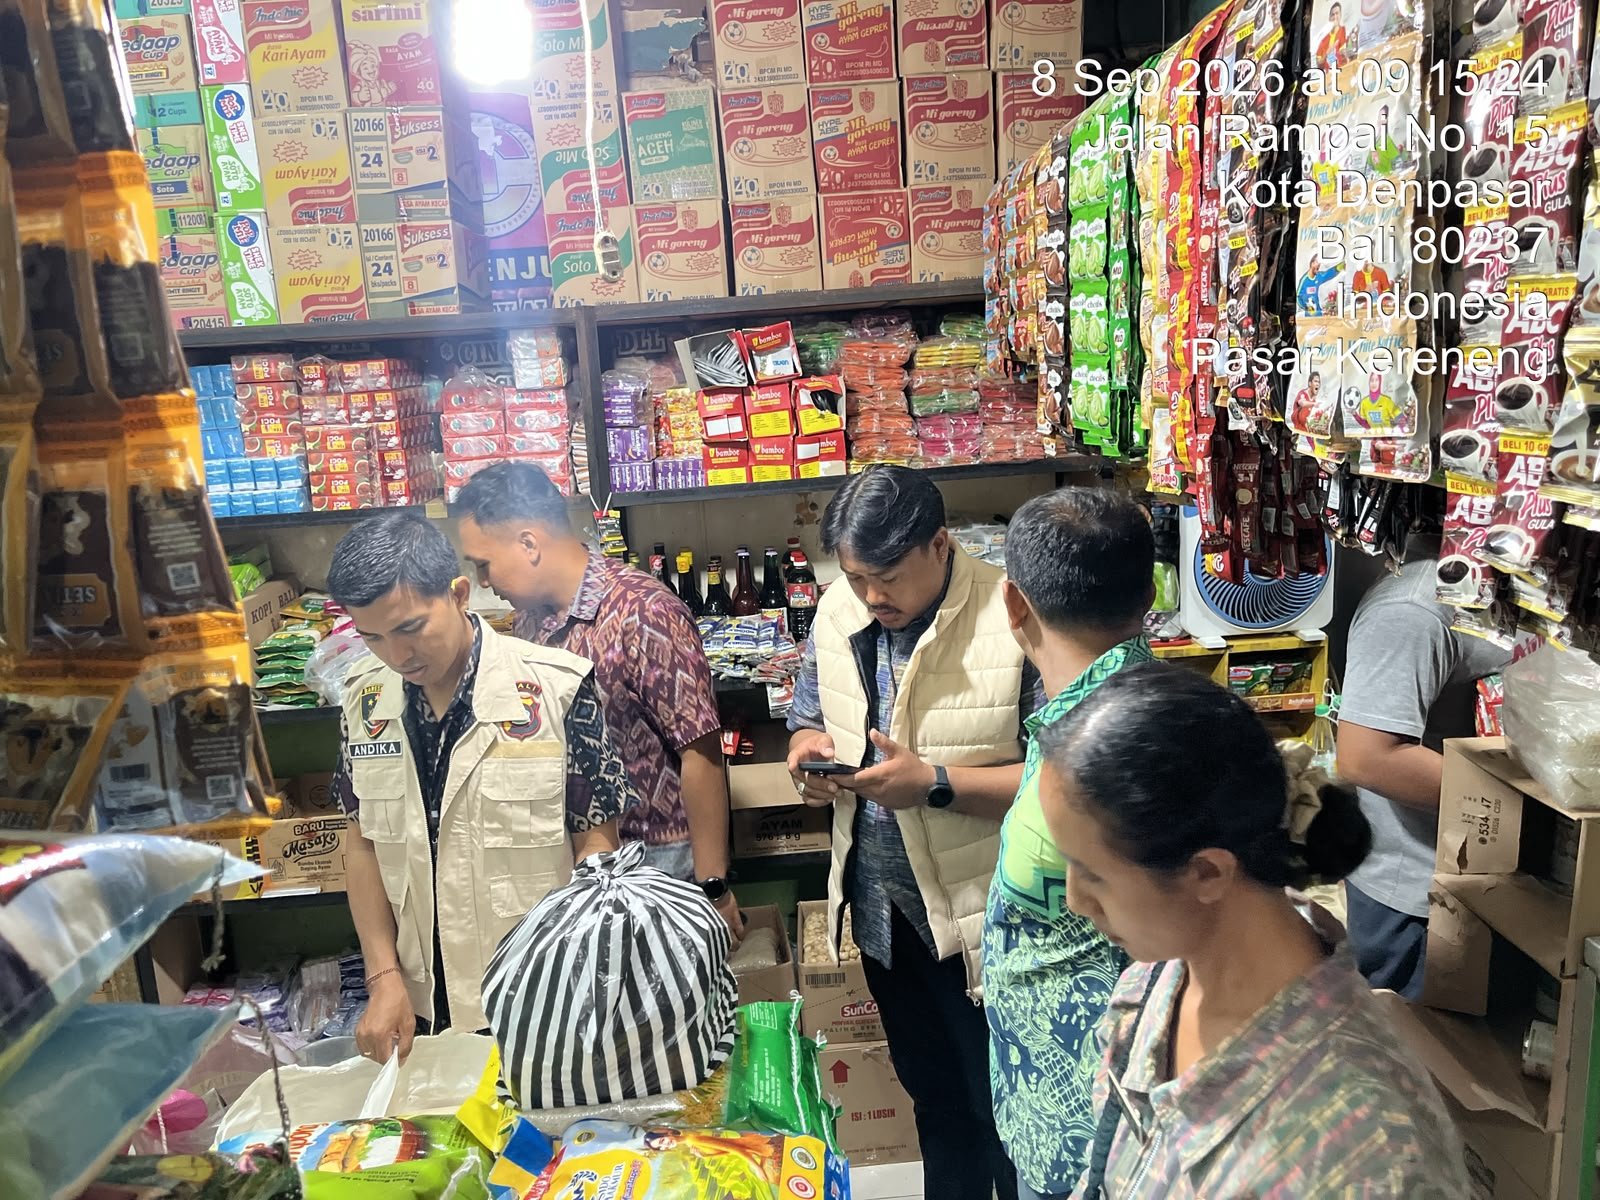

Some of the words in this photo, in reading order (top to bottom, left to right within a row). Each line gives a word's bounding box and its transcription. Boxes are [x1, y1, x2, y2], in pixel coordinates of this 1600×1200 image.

[351, 7, 422, 22] sarimi
[728, 7, 746, 19] Mi
[745, 6, 785, 20] goreng
[808, 3, 833, 15] HYPE
[810, 12, 831, 21] ABIS
[838, 4, 884, 31] goreng
[915, 19, 955, 32] goreng
[838, 32, 860, 45] AYAM
[860, 22, 889, 38] GEPREK
[142, 51, 164, 60] Cup
[262, 48, 288, 63] Kari
[290, 48, 326, 63] Ayam
[397, 50, 422, 62] AYAM
[845, 61, 864, 69] BPOM
[168, 108, 187, 116] Cups
[920, 108, 940, 120] Mi
[939, 108, 977, 121] goreng
[1033, 106, 1072, 120] goreng
[1487, 96, 1516, 136] Plus
[353, 118, 384, 132] 20166
[737, 123, 755, 136] Mi
[755, 122, 794, 136] goreng
[817, 117, 843, 128] HYPE
[819, 126, 839, 136] ABIS
[847, 117, 892, 144] goreng
[427, 145, 438, 160] 2
[637, 138, 674, 158] ACEH
[847, 145, 868, 158] AYAM
[868, 136, 895, 150] GEPREK
[360, 152, 383, 168] 24
[556, 150, 578, 164] Mie
[164, 168, 185, 177] Cup
[275, 166, 310, 180] Ayam
[310, 168, 337, 180] Kari
[1543, 195, 1573, 214] GULA
[1467, 211, 1484, 222] BELI
[1485, 208, 1494, 218] 10
[926, 219, 943, 230] Mi
[943, 218, 981, 230] goreng
[363, 227, 393, 243] 20166
[745, 234, 763, 245] Mi
[763, 232, 802, 245] goreng
[857, 226, 878, 240] AYAM
[651, 239, 669, 249] Mi
[669, 238, 708, 250] goreng
[829, 233, 856, 249] GEPREK
[833, 240, 879, 266] goreng
[437, 253, 448, 268] 2
[562, 260, 592, 274] Soto
[179, 267, 202, 276] Cup
[371, 262, 394, 277] 24
[288, 274, 323, 287] Ayam
[324, 275, 350, 288] Kari
[1200, 265, 1210, 306] NESCAFE
[1544, 286, 1570, 298] GRATIS
[758, 332, 783, 345] bamboe
[262, 358, 271, 378] POCI
[267, 386, 275, 406] POCI
[709, 394, 735, 405] bamboe
[757, 390, 782, 401] bamboe
[1199, 377, 1209, 419] NESCAFE
[760, 444, 786, 454] bamboe
[820, 438, 838, 448] mboe
[1502, 440, 1522, 450] BELI
[1524, 440, 1535, 452] 10
[715, 448, 741, 457] bamboe
[1503, 455, 1547, 487] AB
[1450, 481, 1468, 492] BELI
[1470, 483, 1479, 494] 10
[1199, 487, 1208, 522] NESCAFE
[1516, 488, 1554, 521] Plus
[1527, 518, 1556, 530] GULA
[251, 600, 273, 625] KOPI
[516, 682, 540, 694] ALI
[354, 742, 397, 755] ANDIKA
[294, 820, 326, 836] BARU
[760, 820, 803, 831] AYAM
[283, 831, 336, 859] Masako
[842, 1002, 879, 1018] SunCo
[851, 1111, 862, 1122] ISI
[872, 1108, 896, 1120] LUSIN
